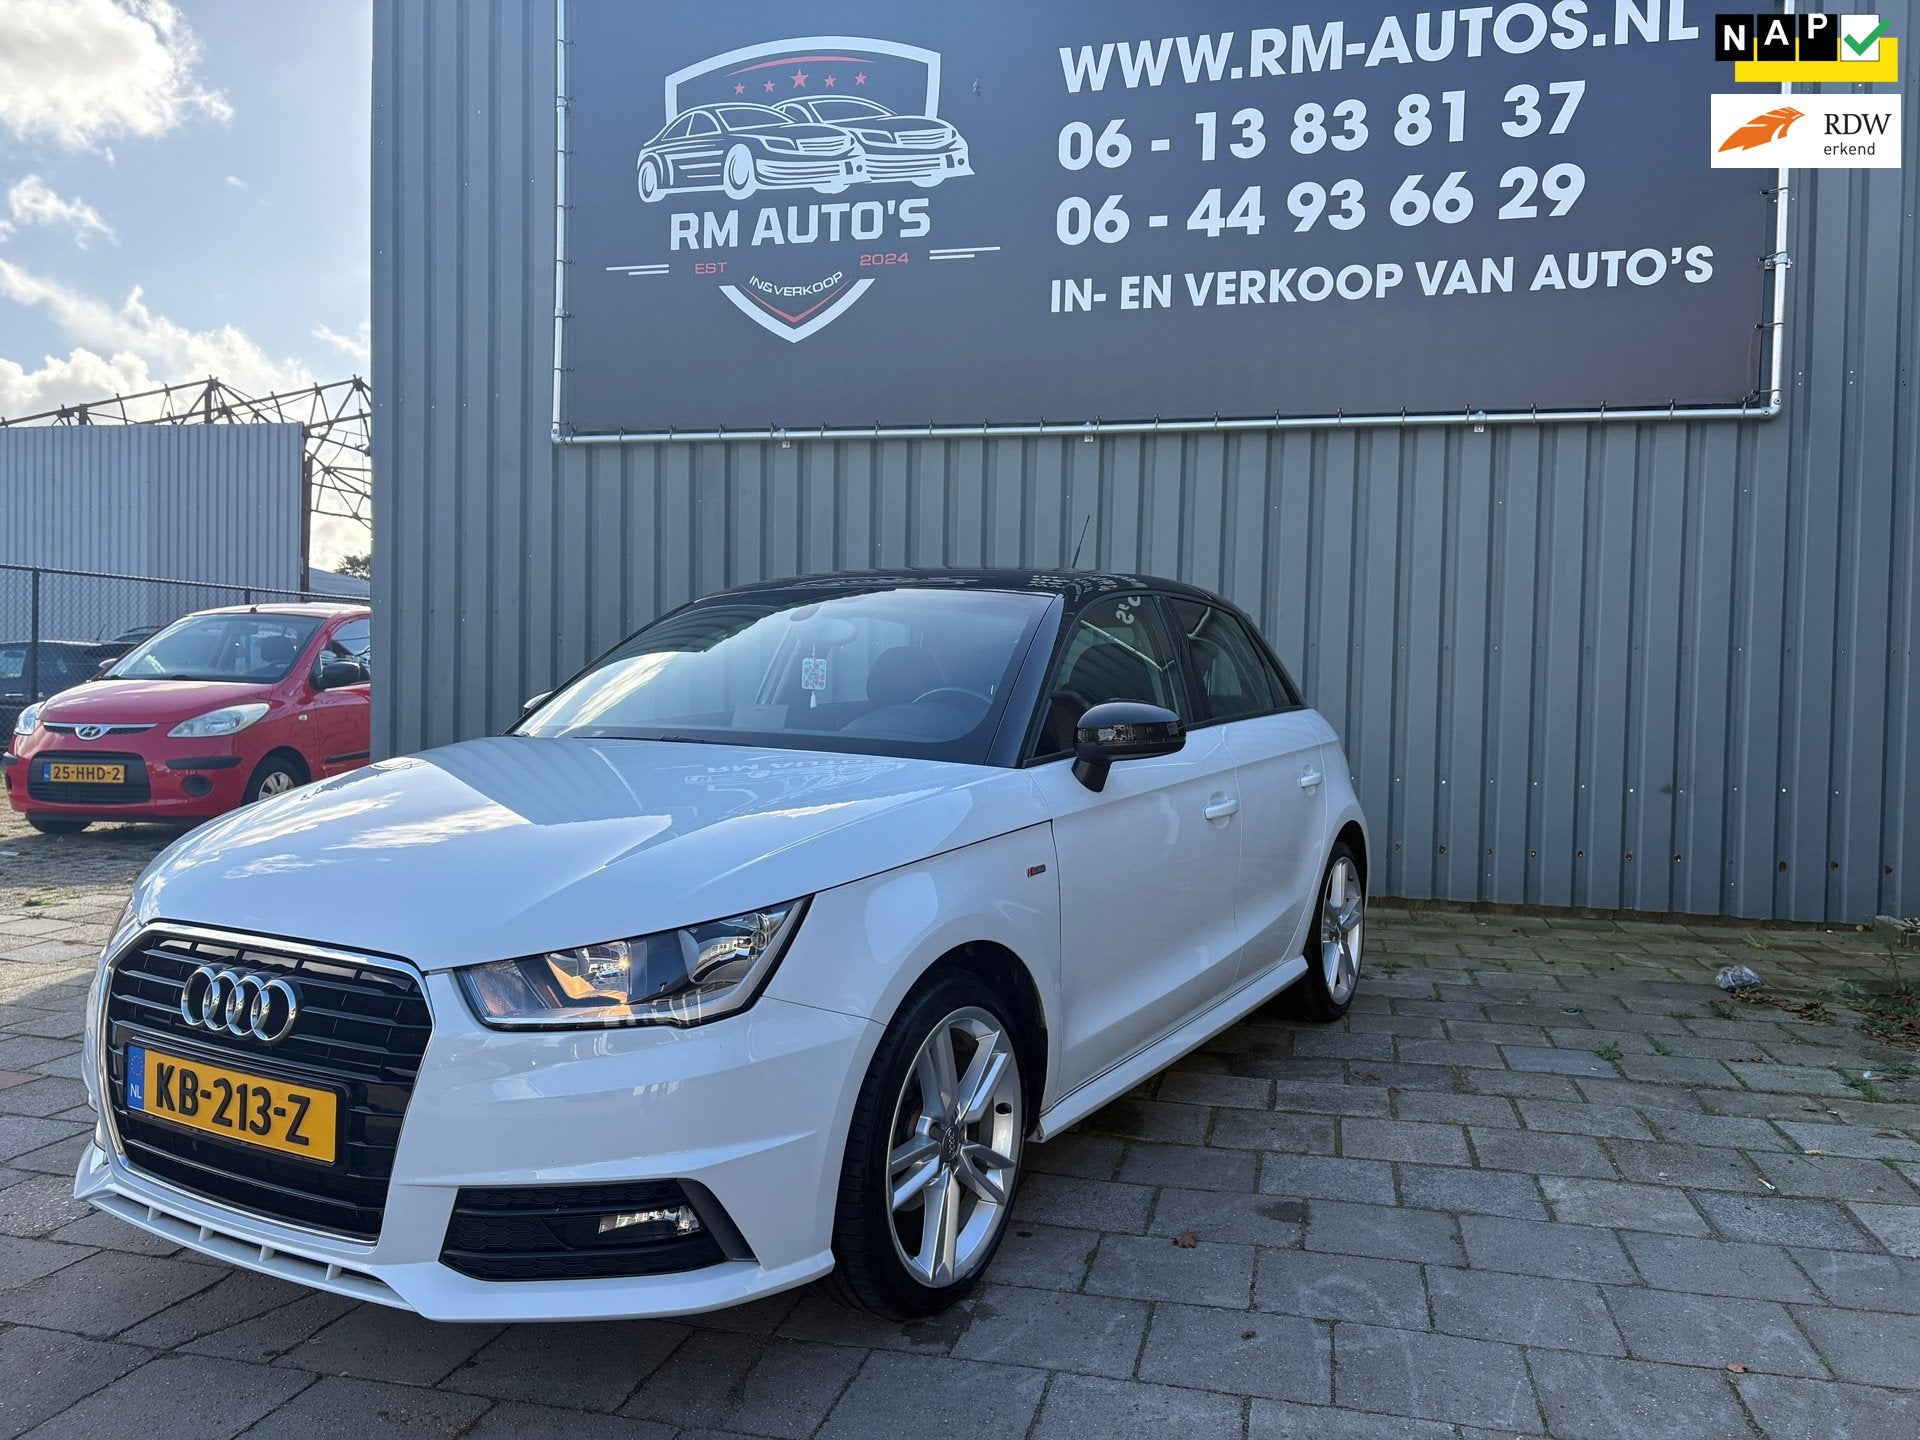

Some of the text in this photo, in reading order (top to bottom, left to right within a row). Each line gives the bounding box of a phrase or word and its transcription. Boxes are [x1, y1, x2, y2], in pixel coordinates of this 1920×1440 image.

[1058, 0, 1699, 94] WWW.RM-AUTOS.NL
[1058, 118, 1132, 171] 06
[1195, 107, 1267, 162] 13
[1290, 98, 1369, 155] 83
[1394, 89, 1466, 147] 81
[1501, 80, 1587, 138] 37
[670, 197, 931, 252] RM AUTO'S
[1056, 194, 1130, 246] 06
[1186, 185, 1266, 238] 44
[1286, 178, 1366, 233] 93
[1389, 171, 1474, 227] 66
[1498, 162, 1586, 221] 29
[694, 252, 910, 275] EST 2024
[1050, 244, 1715, 313] IN- EN VERKOOP VAN AUTO'S
[53, 765, 121, 781] 25-HHD-2
[129, 1080, 143, 1100] NL
[155, 1061, 312, 1147] KB-213-Z
